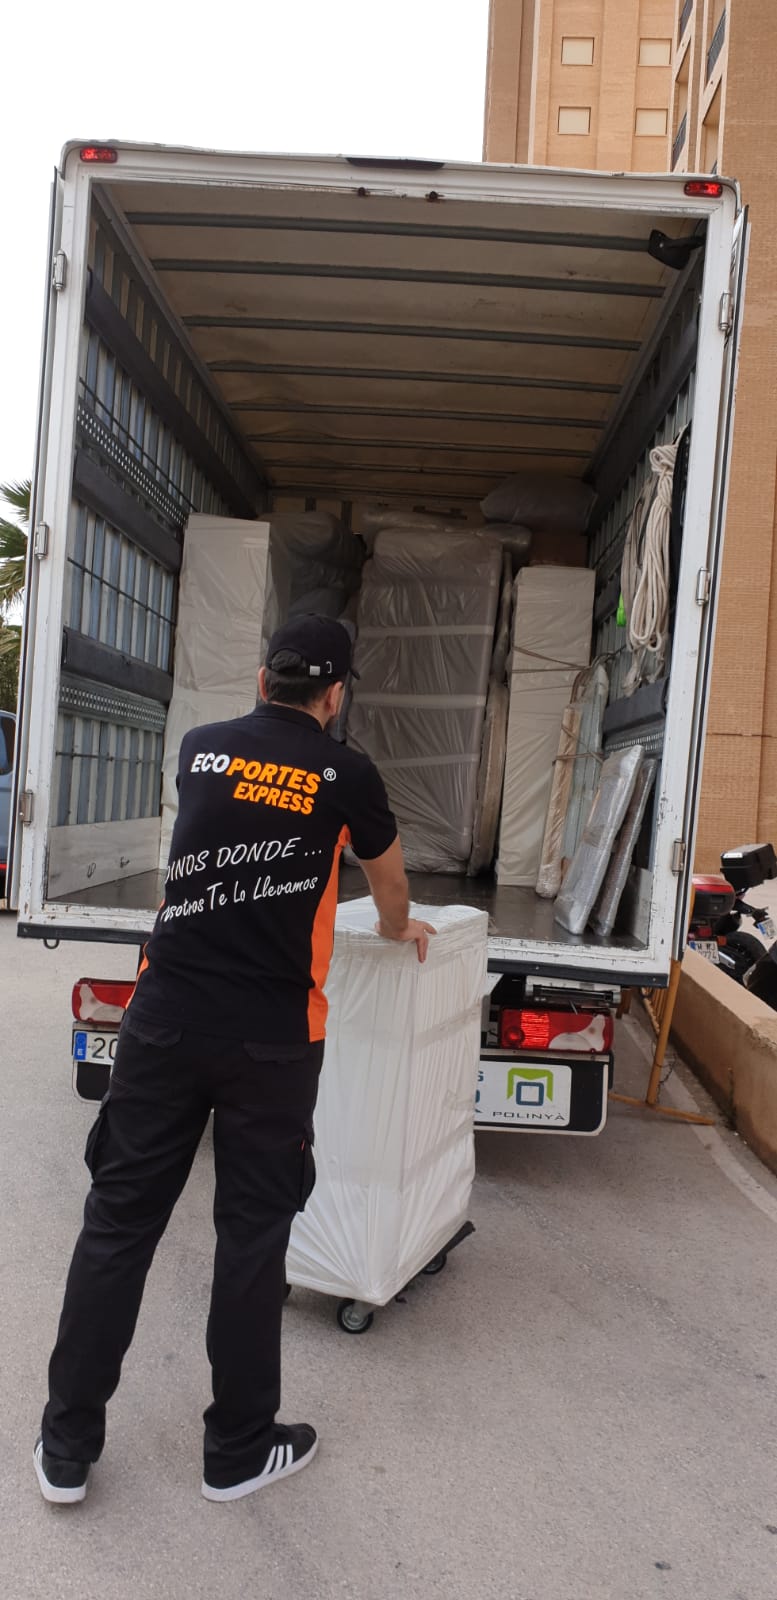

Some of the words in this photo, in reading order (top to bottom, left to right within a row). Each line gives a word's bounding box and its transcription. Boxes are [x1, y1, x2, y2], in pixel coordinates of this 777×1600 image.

[233, 781, 315, 816] EXPRESS
[216, 837, 301, 869] DONDE
[207, 881, 228, 911] Te
[233, 880, 246, 904] Lo
[253, 875, 319, 901] Llevamos
[492, 1111, 565, 1121] POLINYÀ
